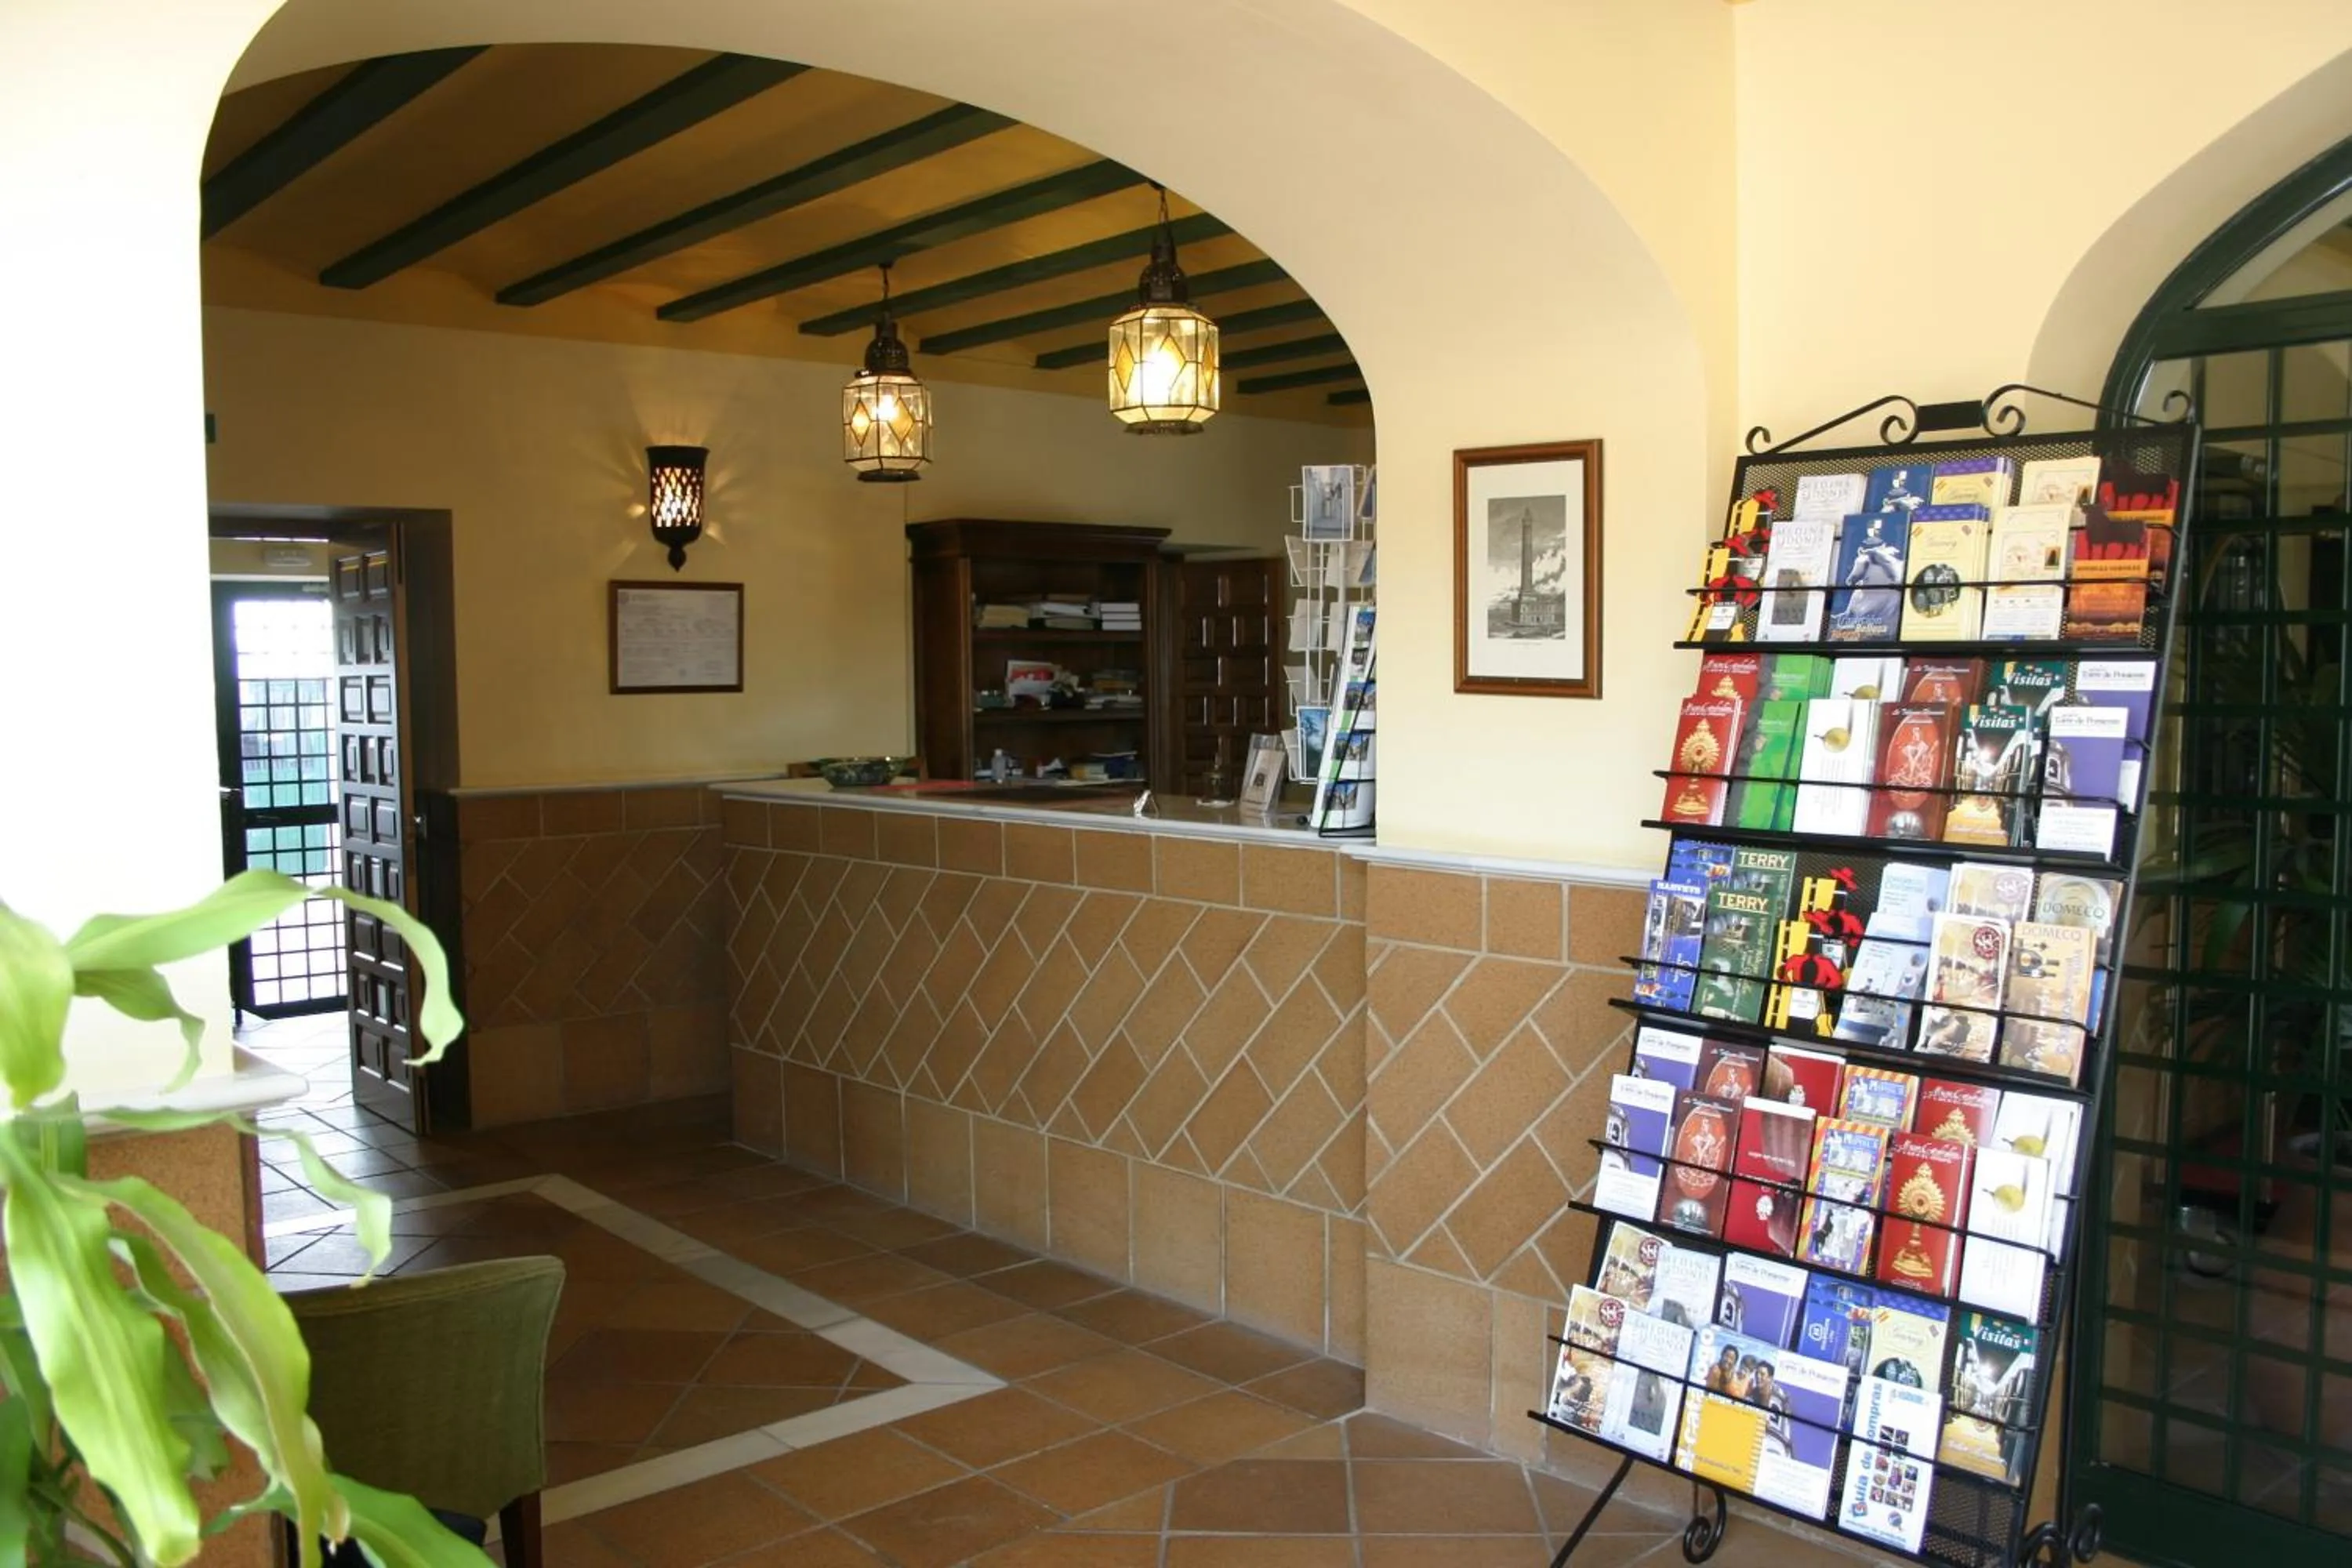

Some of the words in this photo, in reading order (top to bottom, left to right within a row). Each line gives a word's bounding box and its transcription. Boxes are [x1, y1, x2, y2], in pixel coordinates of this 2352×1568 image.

[2005, 673, 2053, 686] Visitas
[1970, 714, 2017, 728] Visitas
[1738, 851, 1790, 868] TERRY
[1718, 891, 1769, 910] TERRY
[2042, 902, 2106, 920] DOMECQ
[2021, 927, 2083, 942] DOMECQ
[1973, 1326, 2022, 1349] Visitas
[1860, 1450, 1874, 1470] de
